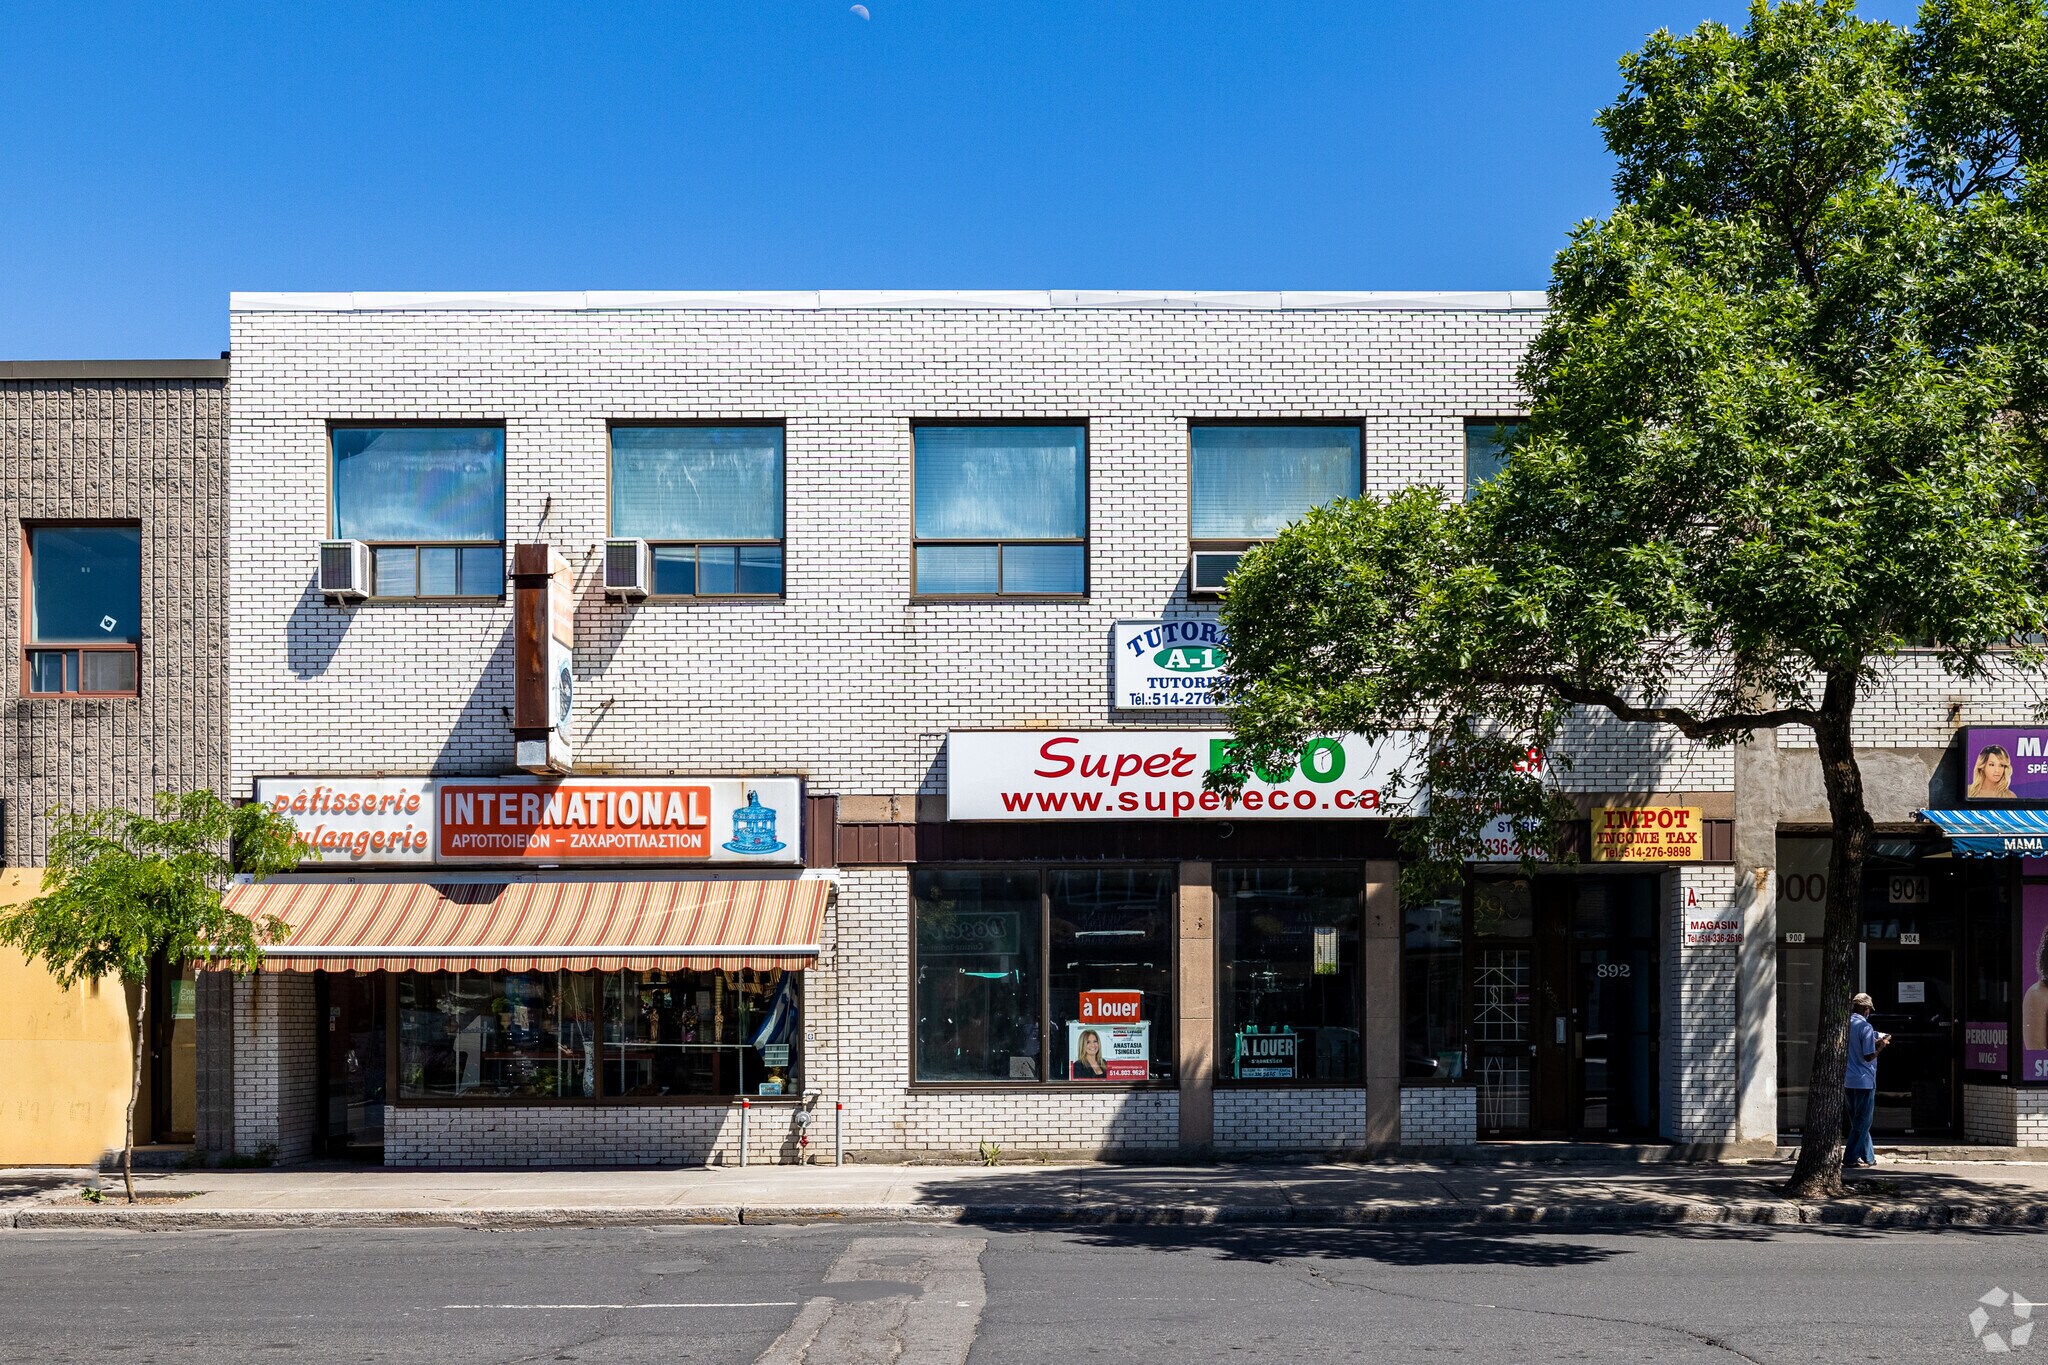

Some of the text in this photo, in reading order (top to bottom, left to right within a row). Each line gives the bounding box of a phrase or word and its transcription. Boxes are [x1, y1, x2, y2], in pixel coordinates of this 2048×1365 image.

[1127, 621, 1233, 658] TUTORA
[1165, 648, 1216, 669] A-1
[1034, 737, 1197, 787] Super
[272, 785, 421, 813] pâtisserie
[444, 791, 708, 826] INTERNATIONAL
[1604, 807, 1690, 828] IMPÔT
[1497, 821, 1538, 833] STRE
[270, 823, 429, 857] ulangerie
[1597, 832, 1698, 844] INCOME TAX
[2004, 838, 2044, 850] MAMA
[1604, 846, 1691, 857] Tel.:514-276-9898
[1891, 877, 1927, 901] 904
[1690, 921, 1738, 930] MAGASIN
[1789, 934, 1803, 942] 900
[1904, 934, 1917, 943] 904
[1597, 963, 1631, 978] 892
[1083, 998, 1139, 1017] à louer
[1252, 1038, 1294, 1056] LOUER
[1978, 1052, 1997, 1064] WIGS
